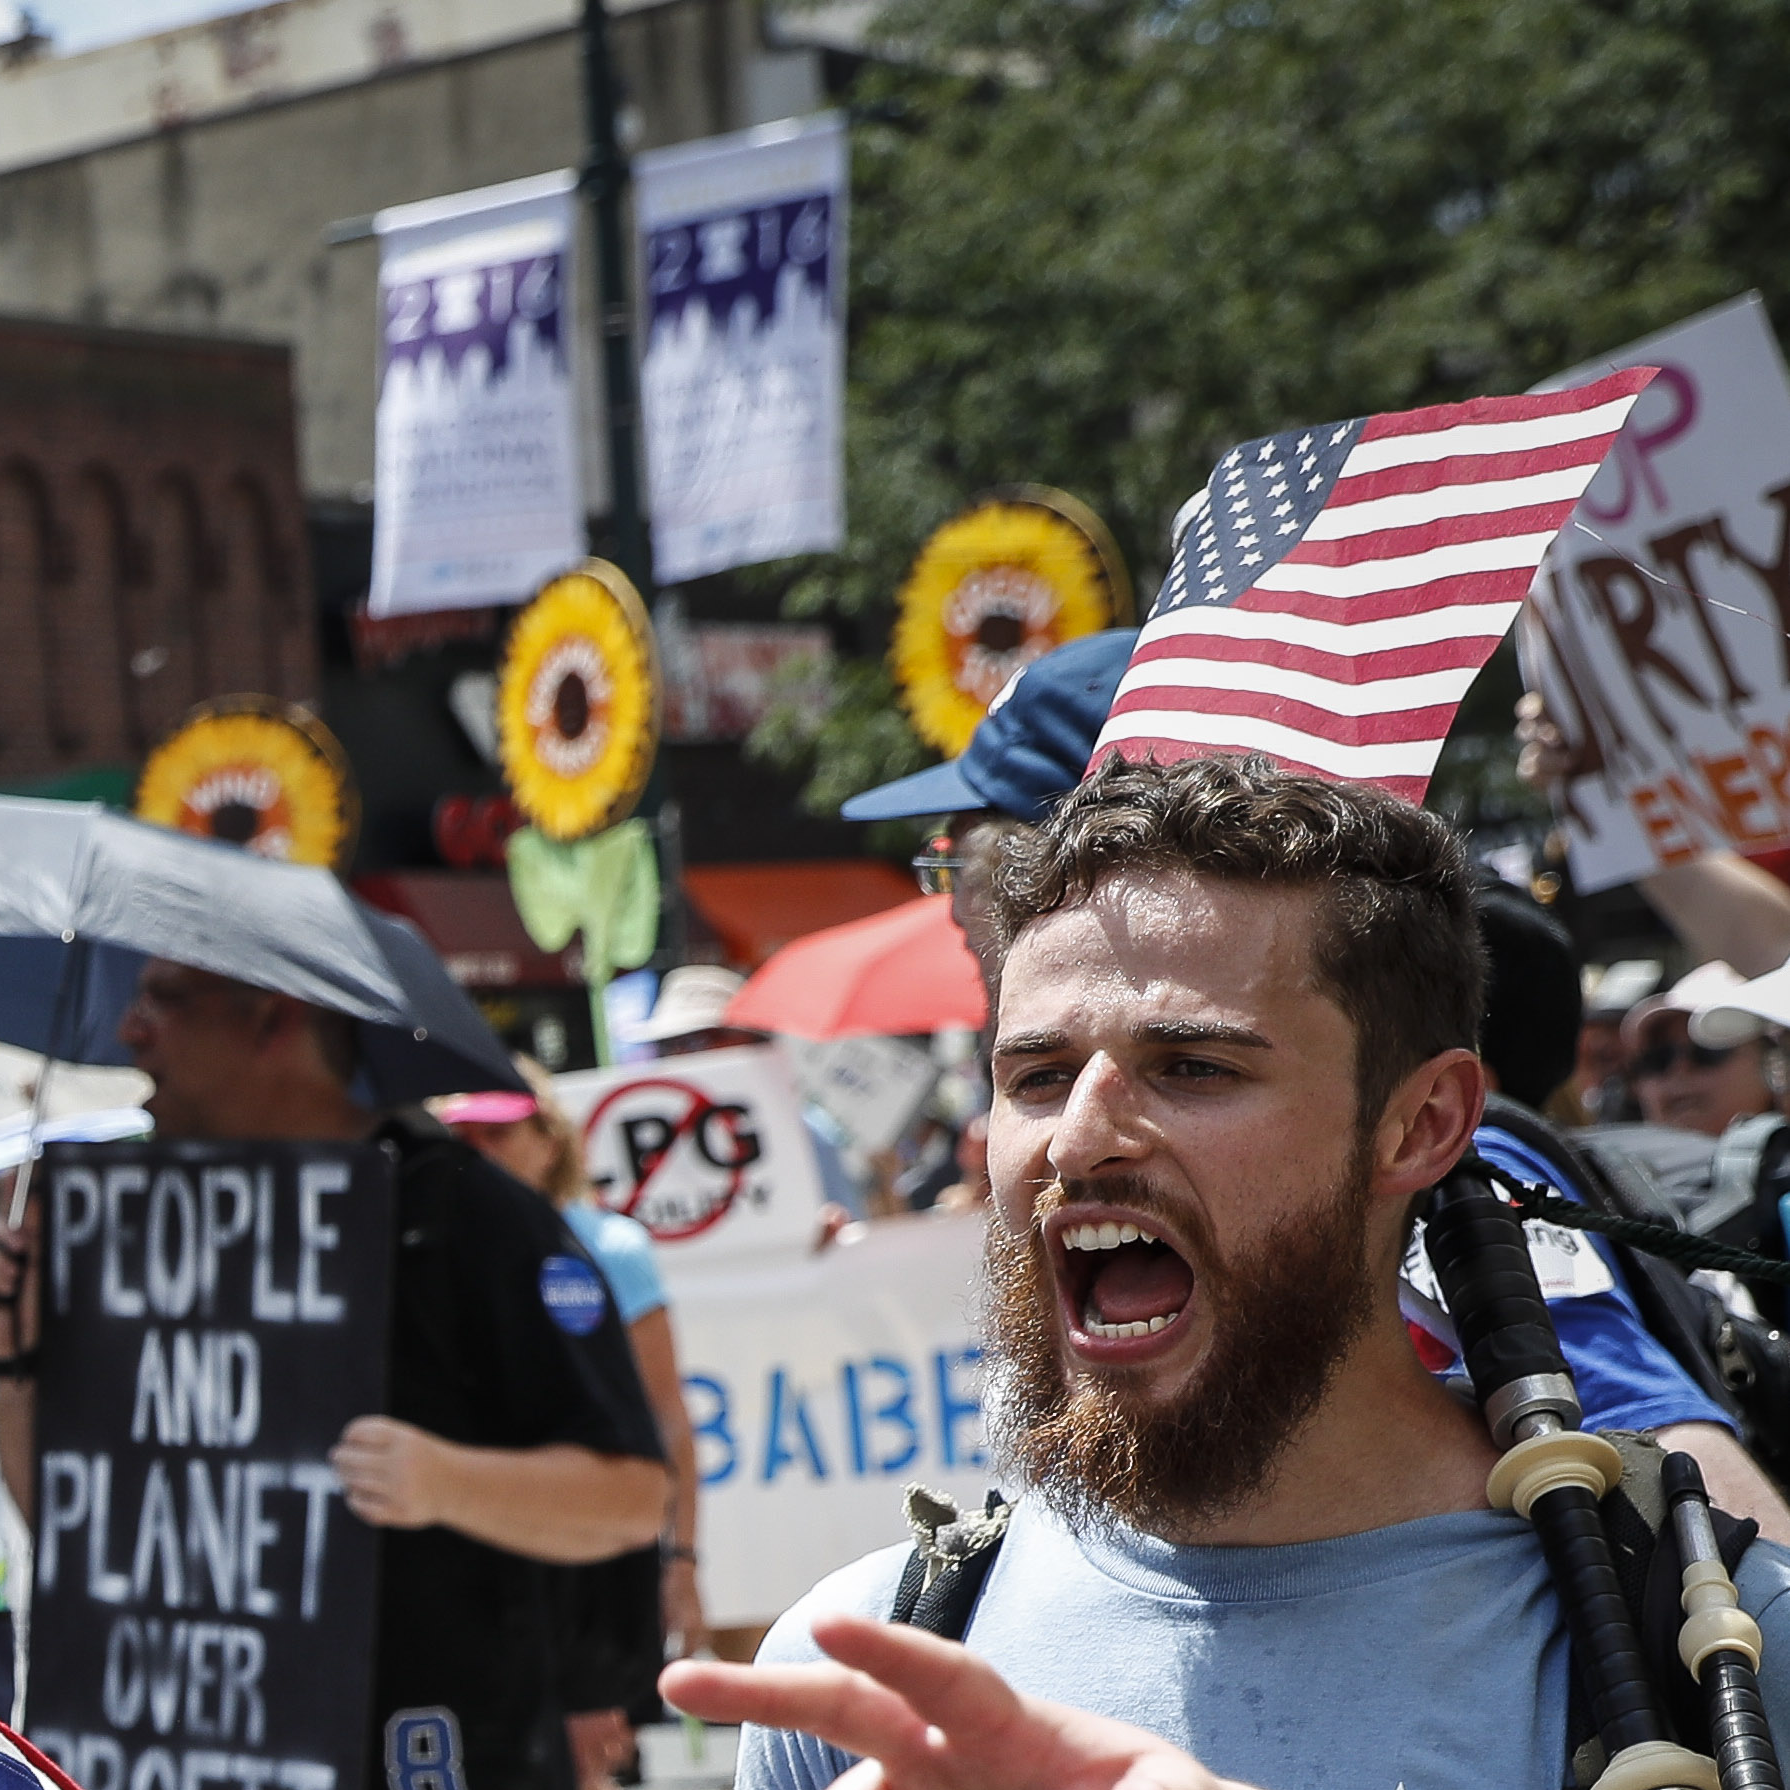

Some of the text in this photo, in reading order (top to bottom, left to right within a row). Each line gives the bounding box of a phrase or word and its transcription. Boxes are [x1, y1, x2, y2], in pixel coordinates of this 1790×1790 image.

[51, 1160, 352, 1324] PEOPLE
[130, 1327, 264, 1448] AND
[37, 1450, 345, 1624] PLANET
[103, 1615, 270, 1748] OVER
